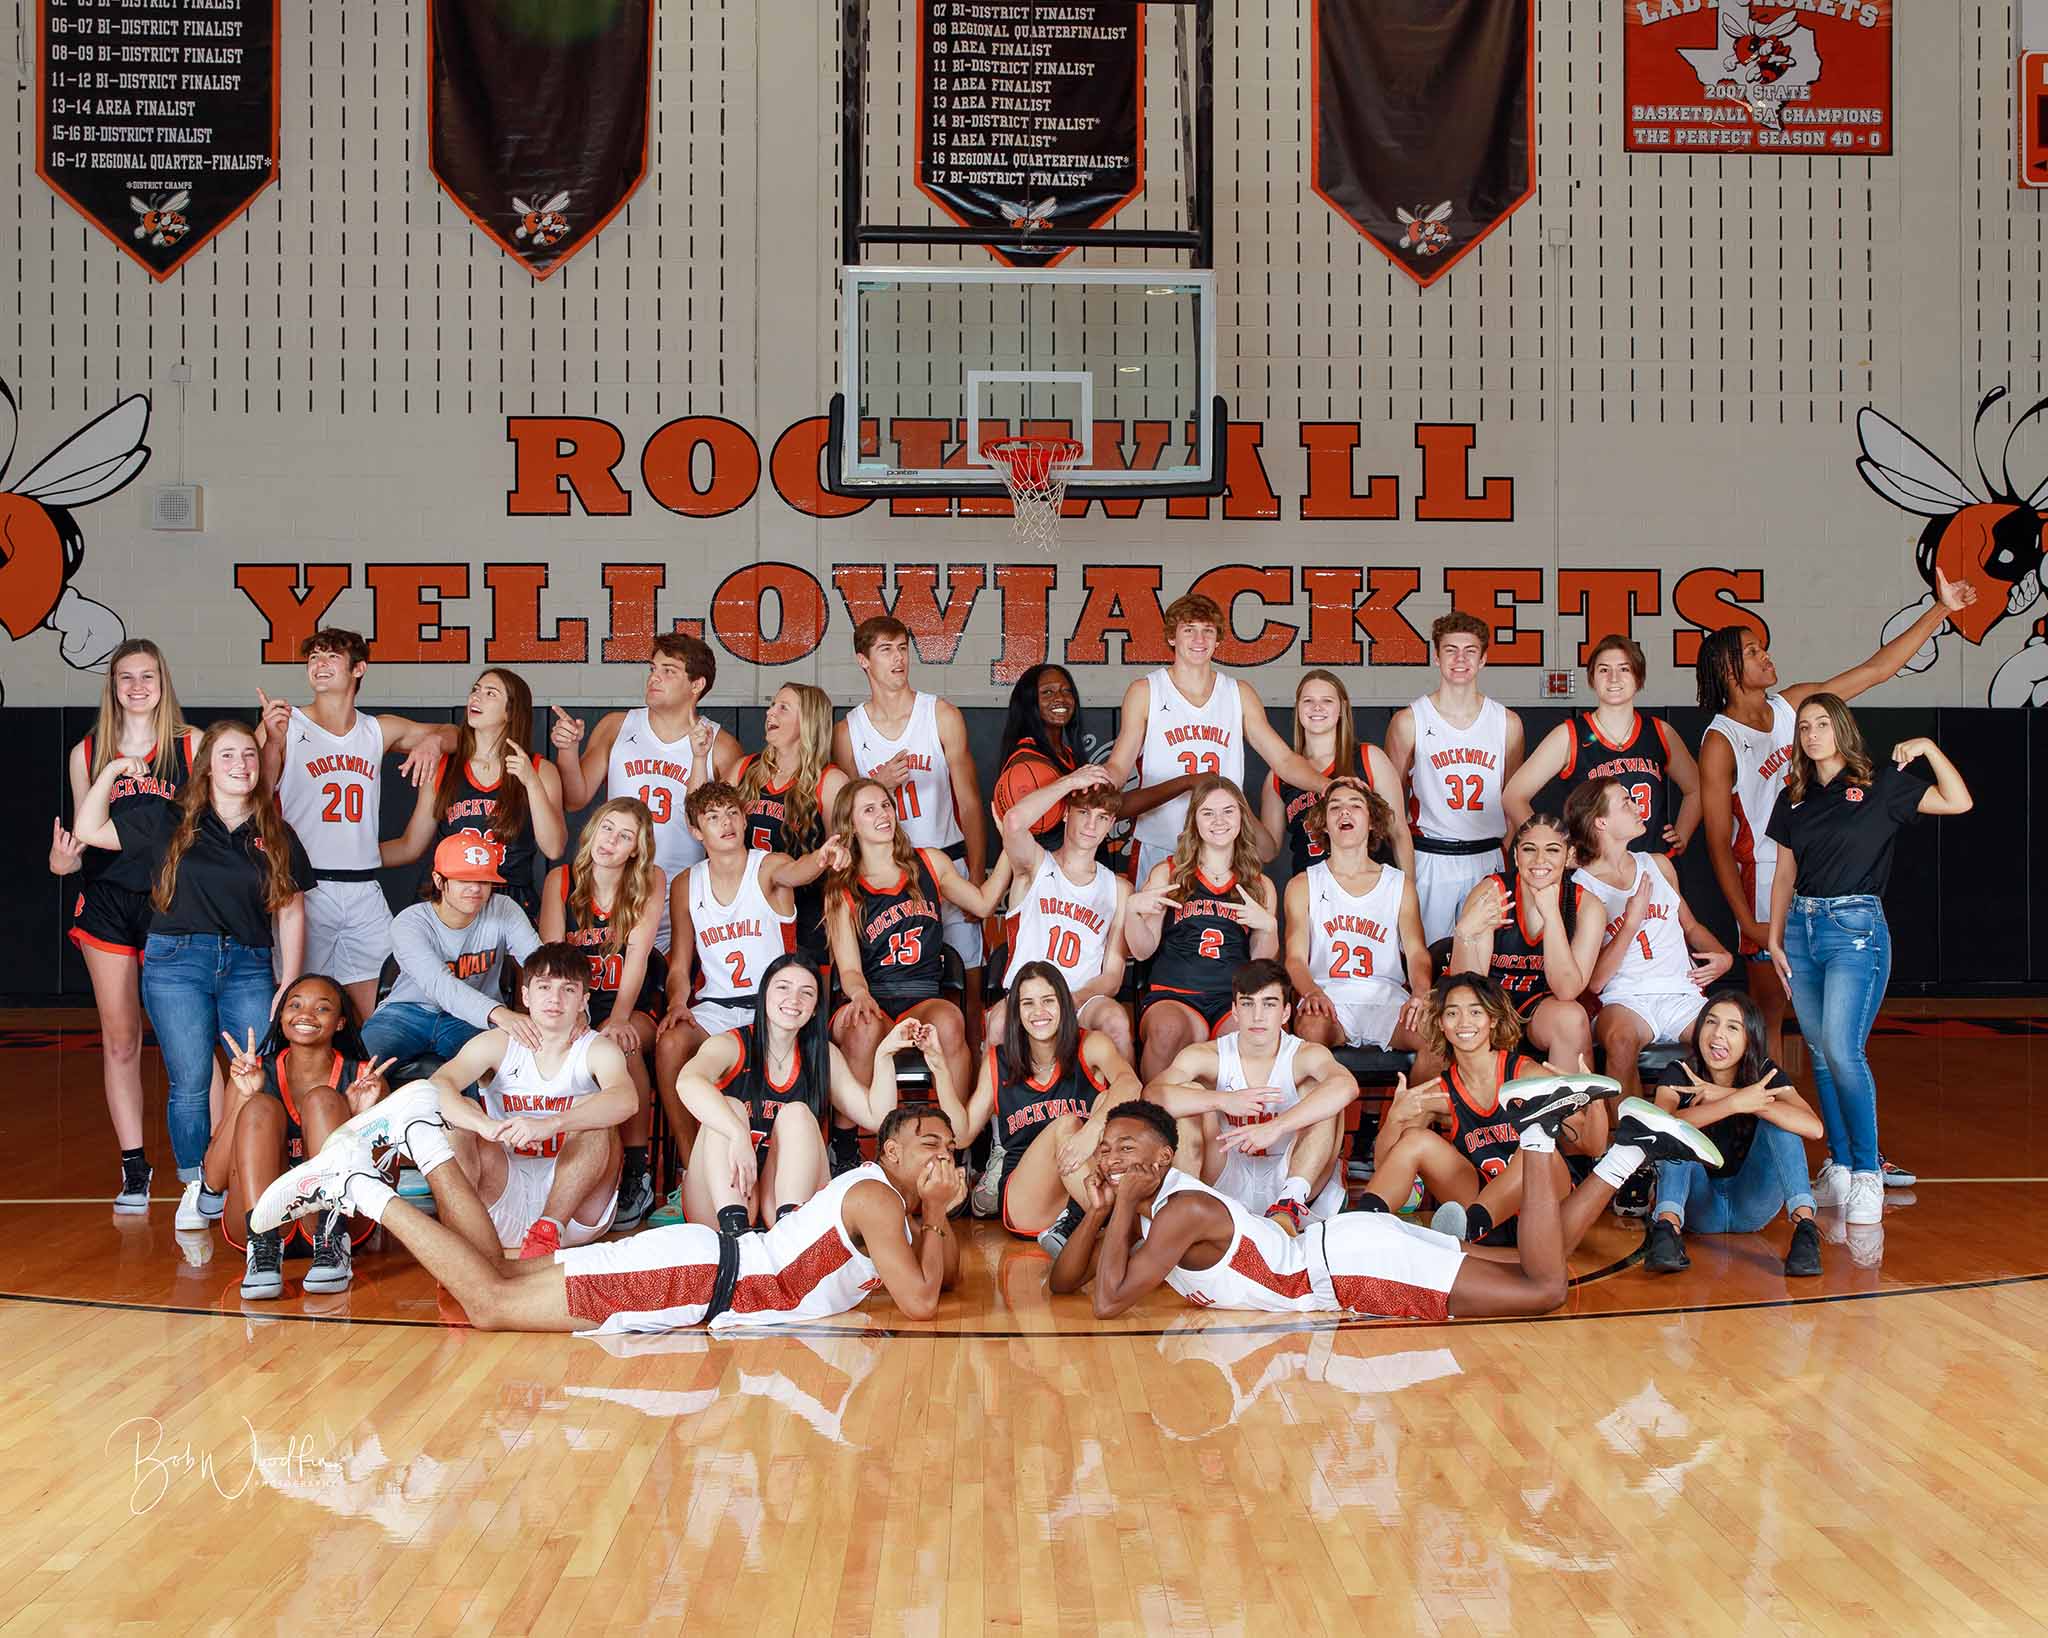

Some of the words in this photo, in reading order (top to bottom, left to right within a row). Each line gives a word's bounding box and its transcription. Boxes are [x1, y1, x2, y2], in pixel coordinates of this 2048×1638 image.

[933, 4, 947, 17] 07
[951, 4, 1030, 20] BI-DISTRICT
[1035, 7, 1096, 21] FINALIST
[51, 18, 94, 34] 06-07
[97, 19, 180, 36] BI-DISTRICT
[183, 20, 243, 37] FINALIST
[933, 23, 947, 36] 08
[951, 22, 1010, 38] REGIONAL
[1014, 25, 1128, 41] QUARTERFINALIST
[51, 45, 94, 61] 08-09
[98, 46, 180, 63] BI-DISTRICT
[183, 48, 244, 64] FINALIST
[933, 41, 948, 54] 09
[952, 41, 987, 55] AREA
[991, 42, 1052, 57] FINALIST
[933, 60, 946, 73] 11
[952, 59, 1030, 75] BI-DISTRICT
[1034, 62, 1095, 77] FINALIST
[51, 72, 92, 88] 11-12
[96, 73, 178, 90] BI-DISTRICT
[181, 74, 241, 91] FINALIST
[933, 78, 947, 91] 12
[952, 78, 987, 92] AREA
[991, 79, 1052, 94] FINALIST
[1704, 85, 1747, 99] 2007
[1753, 85, 1810, 100] STATE
[51, 99, 91, 115] 13-14
[96, 99, 132, 115] AREA
[136, 100, 196, 117] FINALIST
[933, 96, 947, 109] 13
[952, 96, 987, 110] AREA
[991, 97, 1052, 112] FINALIST
[933, 114, 947, 128] 14
[952, 115, 1030, 129] BI-DISTRICT
[1632, 106, 1747, 122] BASKETBALL
[1753, 107, 1777, 122] 5A
[1783, 107, 1882, 123] CHAMPIONS
[51, 125, 81, 141] 15-16
[83, 126, 154, 143] BI-DISTRICT
[156, 127, 213, 144] FINALIST
[933, 133, 947, 146] 15
[951, 133, 986, 147] AREA
[1633, 128, 1670, 145] THE
[1675, 129, 1752, 145] PERFECT
[1759, 129, 1825, 145] SEASON
[1831, 131, 1852, 146] 40
[1869, 131, 1881, 146] 0
[51, 152, 87, 169] 16-17
[91, 153, 147, 169] REGIONAL
[932, 152, 946, 165] 16
[950, 152, 1009, 166] REGIONAL
[164, 181, 193, 190] CHAMPS
[931, 170, 945, 184] 17
[949, 170, 1025, 185] BI-DISTRICT
[505, 415, 1515, 522] ROCKWALL
[233, 560, 1773, 686] YELLOWJACKETS
[1164, 724, 1231, 748] ROCKWALL
[305, 754, 376, 782] ROCKWALL
[1431, 747, 1497, 771] ROCKWALL
[1445, 774, 1485, 812] 32
[1846, 787, 1864, 802] R
[321, 783, 365, 823] 20
[752, 826, 772, 853] 5
[463, 845, 490, 866] R
[866, 899, 939, 944] ROCKWALL
[1040, 897, 1106, 935] ROCKWALL
[880, 926, 924, 967] 15
[1046, 925, 1082, 969] 10
[1198, 928, 1225, 961] 2
[1636, 930, 1654, 961] 1
[1328, 940, 1374, 979] 23
[586, 952, 624, 991] 20
[725, 950, 753, 989] 2
[1007, 1099, 1093, 1134] ROCKWALL
